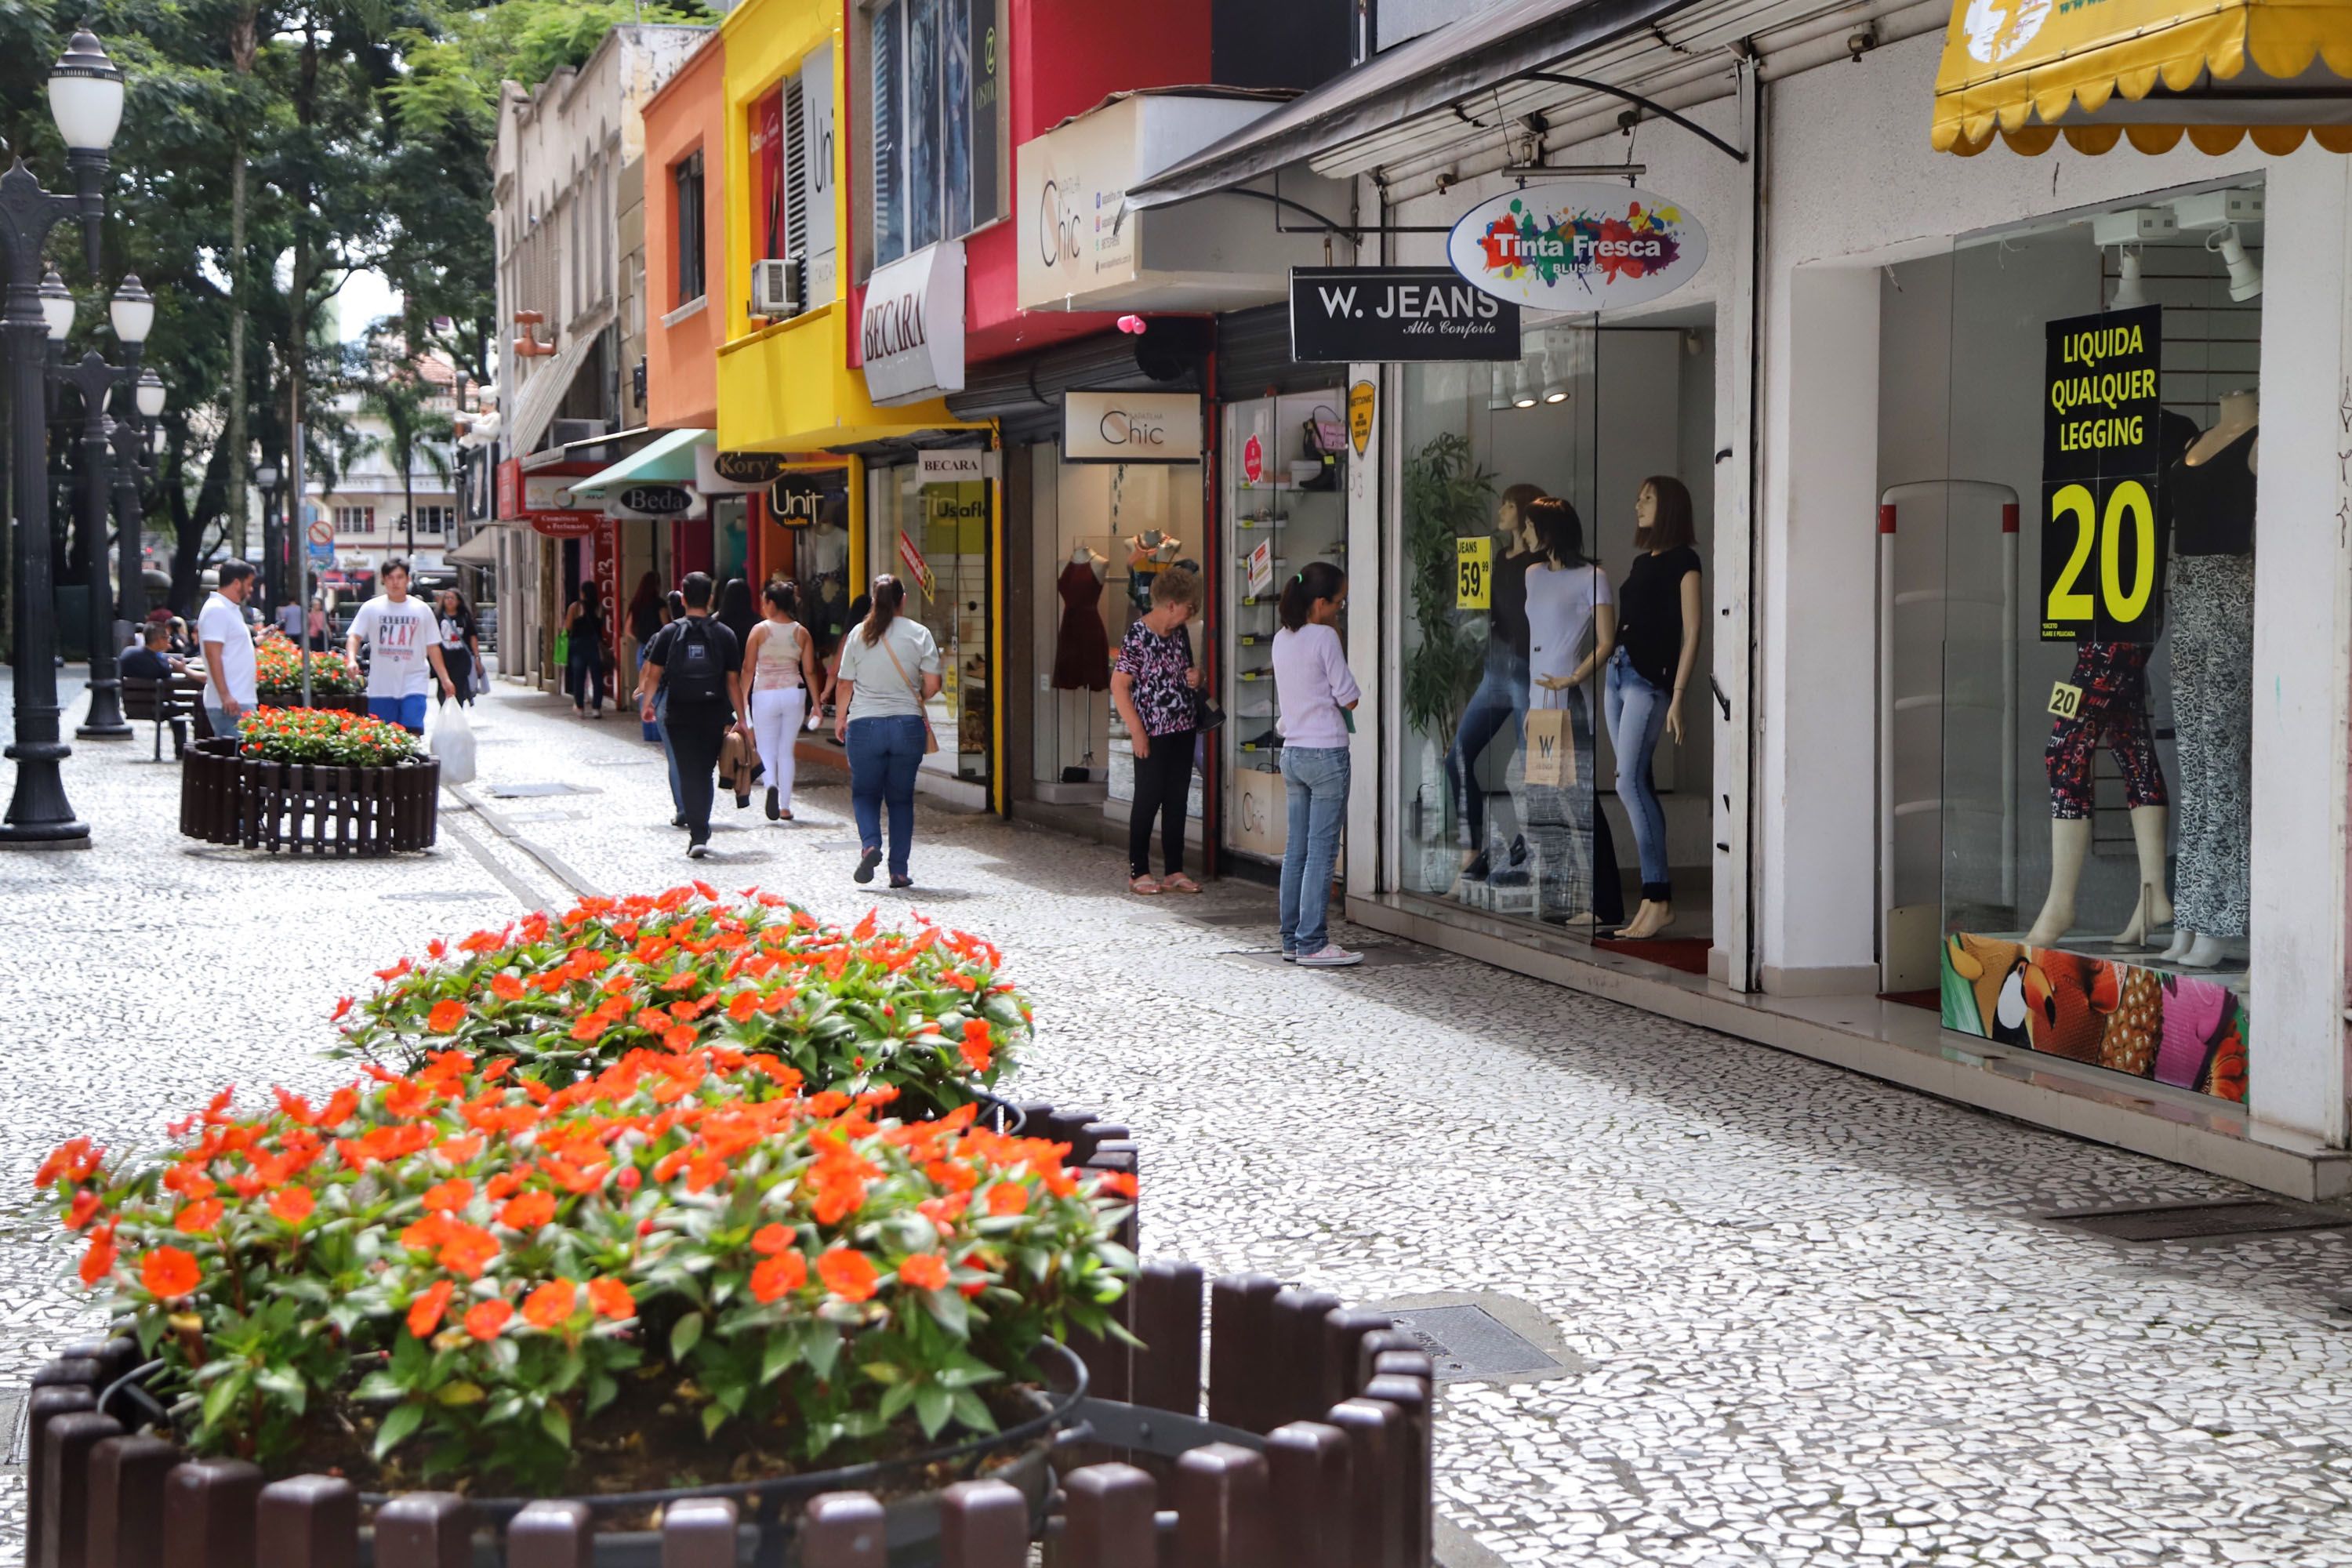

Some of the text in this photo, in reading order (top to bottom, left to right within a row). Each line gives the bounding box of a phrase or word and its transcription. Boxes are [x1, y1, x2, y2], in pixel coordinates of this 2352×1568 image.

[1040, 180, 1080, 267] Chic
[1494, 234, 1661, 256] Tinta Fresca
[1553, 263, 1603, 273] BLUSAS
[1318, 285, 1499, 318] W. JEANS
[866, 289, 925, 361] BECARA
[1403, 320, 1496, 338] Alto Conforto
[2064, 325, 2143, 368] LIQUIDA
[2052, 368, 2156, 416] QUALQUER
[1101, 410, 1163, 445] Chic
[2061, 416, 2143, 451] LEGGING
[924, 459, 978, 471] BECARA
[630, 489, 684, 509] Beda
[772, 482, 824, 524] Unit
[1458, 541, 1477, 554] JEANS
[2047, 480, 2154, 622] 20
[379, 624, 418, 646] CLAY
[1539, 735, 1555, 759] W
